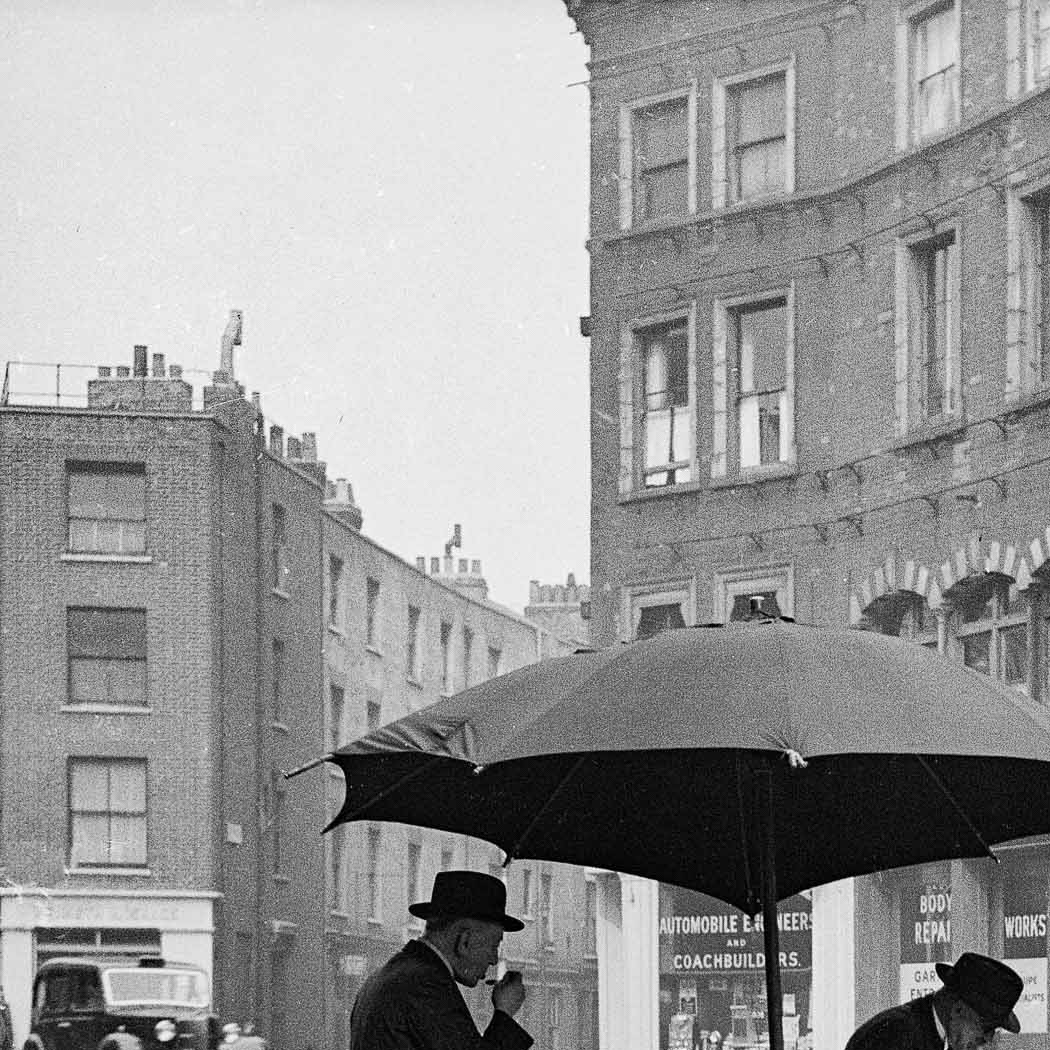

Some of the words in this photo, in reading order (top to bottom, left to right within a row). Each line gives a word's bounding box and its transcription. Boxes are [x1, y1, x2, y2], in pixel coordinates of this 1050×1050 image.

[659, 915, 738, 934] AUTOMOBILE
[1004, 914, 1047, 938] WORKS
[726, 939, 747, 947] AND
[673, 951, 801, 969] COACHBUILDRS.
